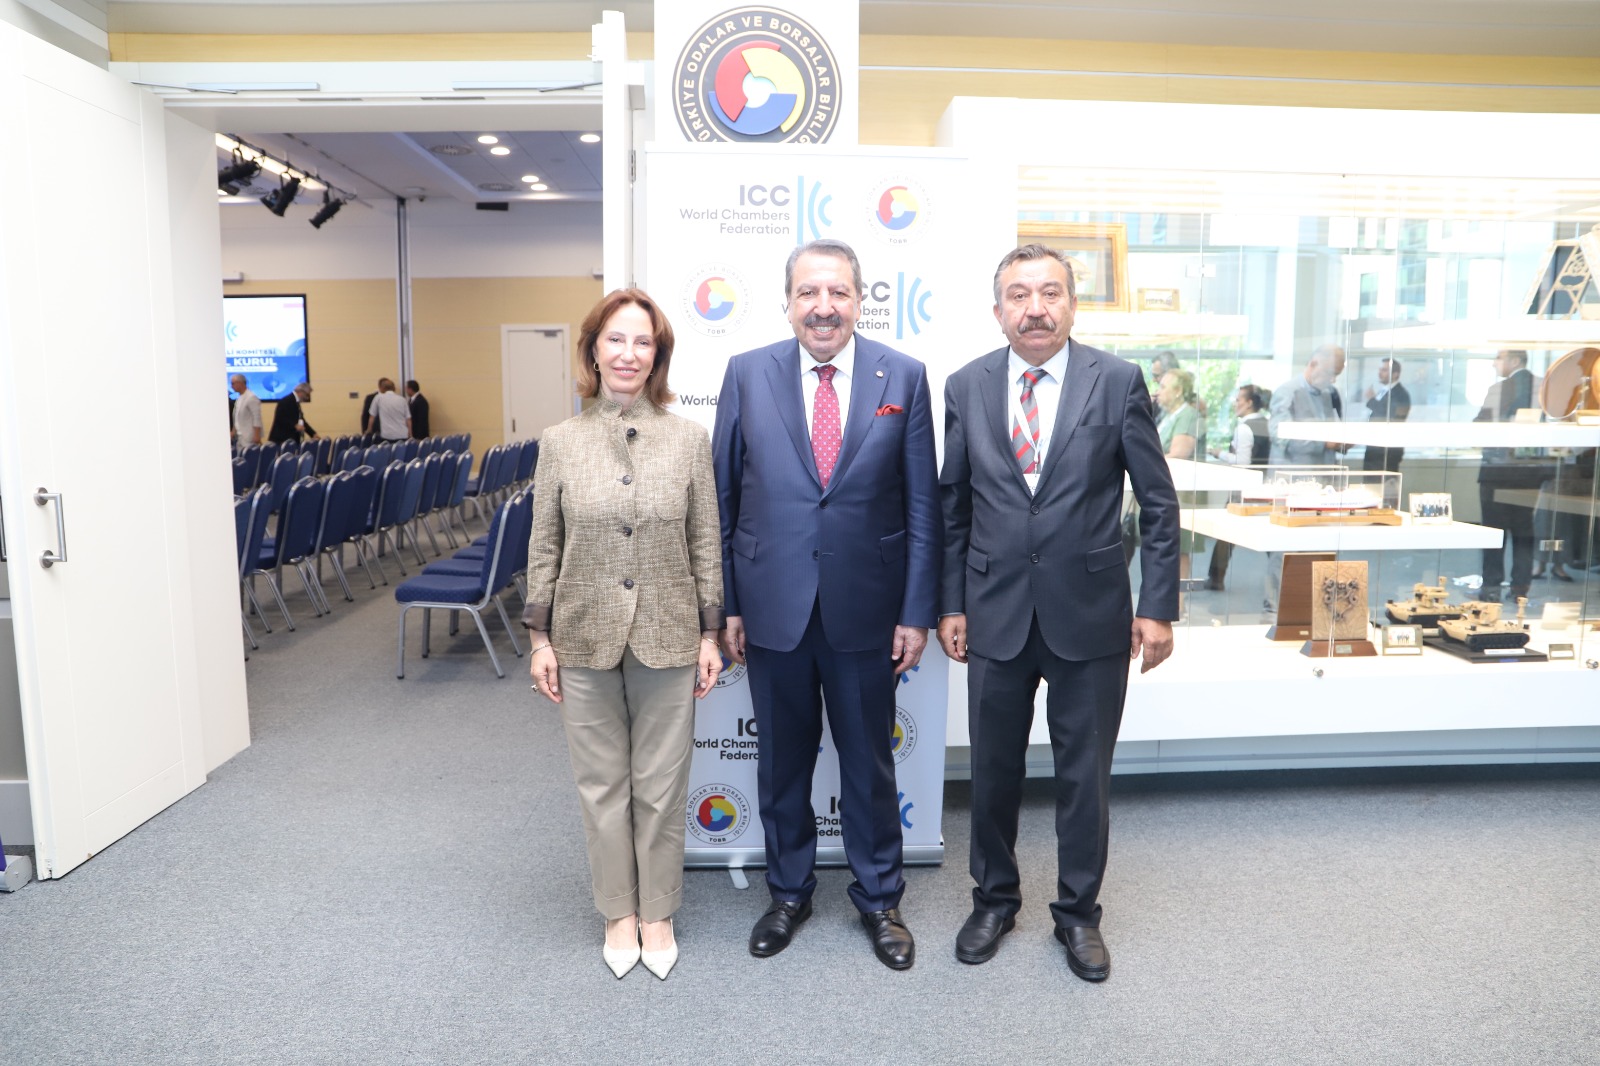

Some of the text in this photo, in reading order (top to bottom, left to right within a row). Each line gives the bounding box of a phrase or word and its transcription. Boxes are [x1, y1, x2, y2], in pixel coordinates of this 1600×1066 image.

[687, 20, 736, 73] ODALAR
[741, 16, 762, 28] VE
[769, 17, 830, 87] BORSALAR
[739, 184, 790, 207] ICC
[679, 208, 790, 221] World Chambers
[719, 222, 790, 235] Federation
[860, 305, 890, 316] bers
[857, 318, 890, 330] ation
[233, 357, 277, 366] KURUL
[679, 394, 718, 406] World
[738, 718, 758, 737] IC
[693, 738, 758, 749] orld Cham
[688, 788, 707, 809] ODALAR
